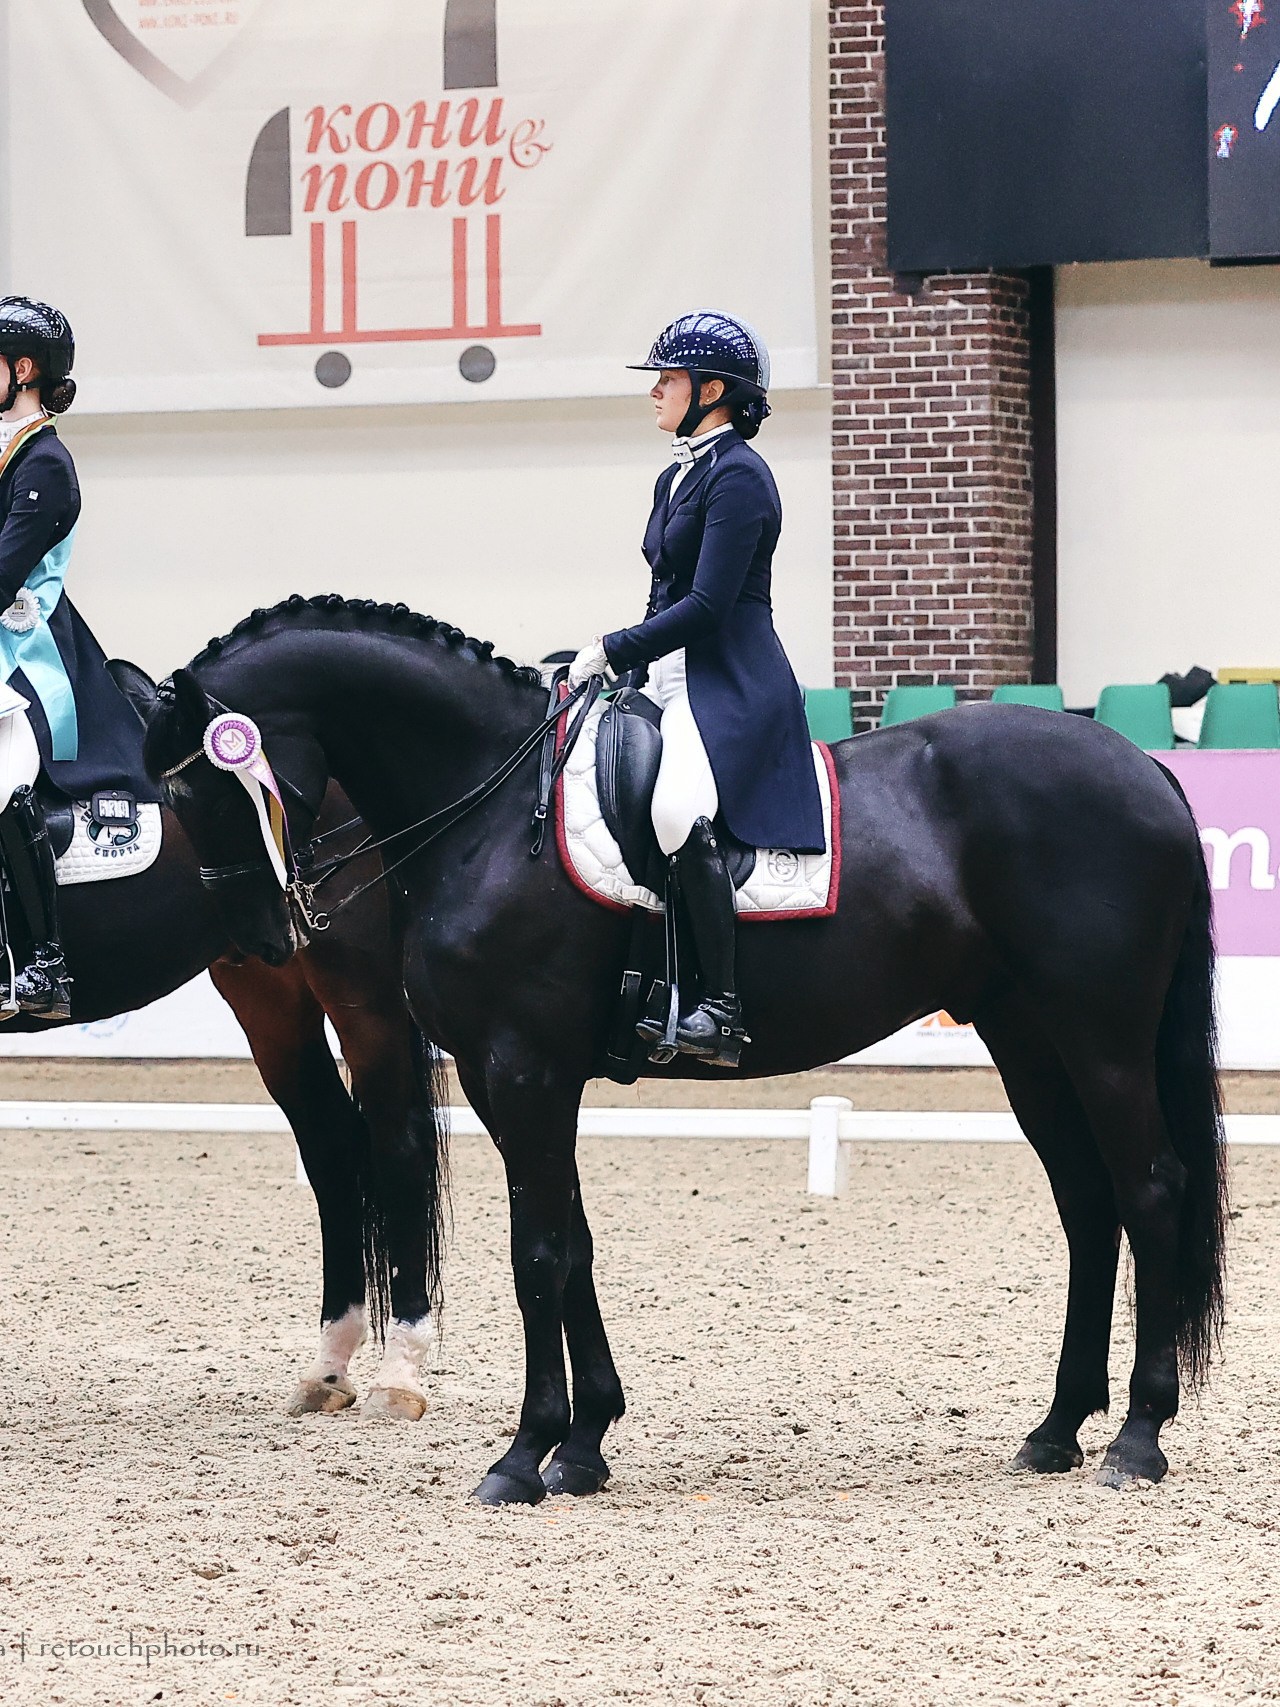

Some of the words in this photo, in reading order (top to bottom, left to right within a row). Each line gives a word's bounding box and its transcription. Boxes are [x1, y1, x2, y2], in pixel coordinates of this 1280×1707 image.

[304, 97, 507, 154] кони
[300, 156, 507, 213] пони
[94, 843, 140, 858] СПОРТА
